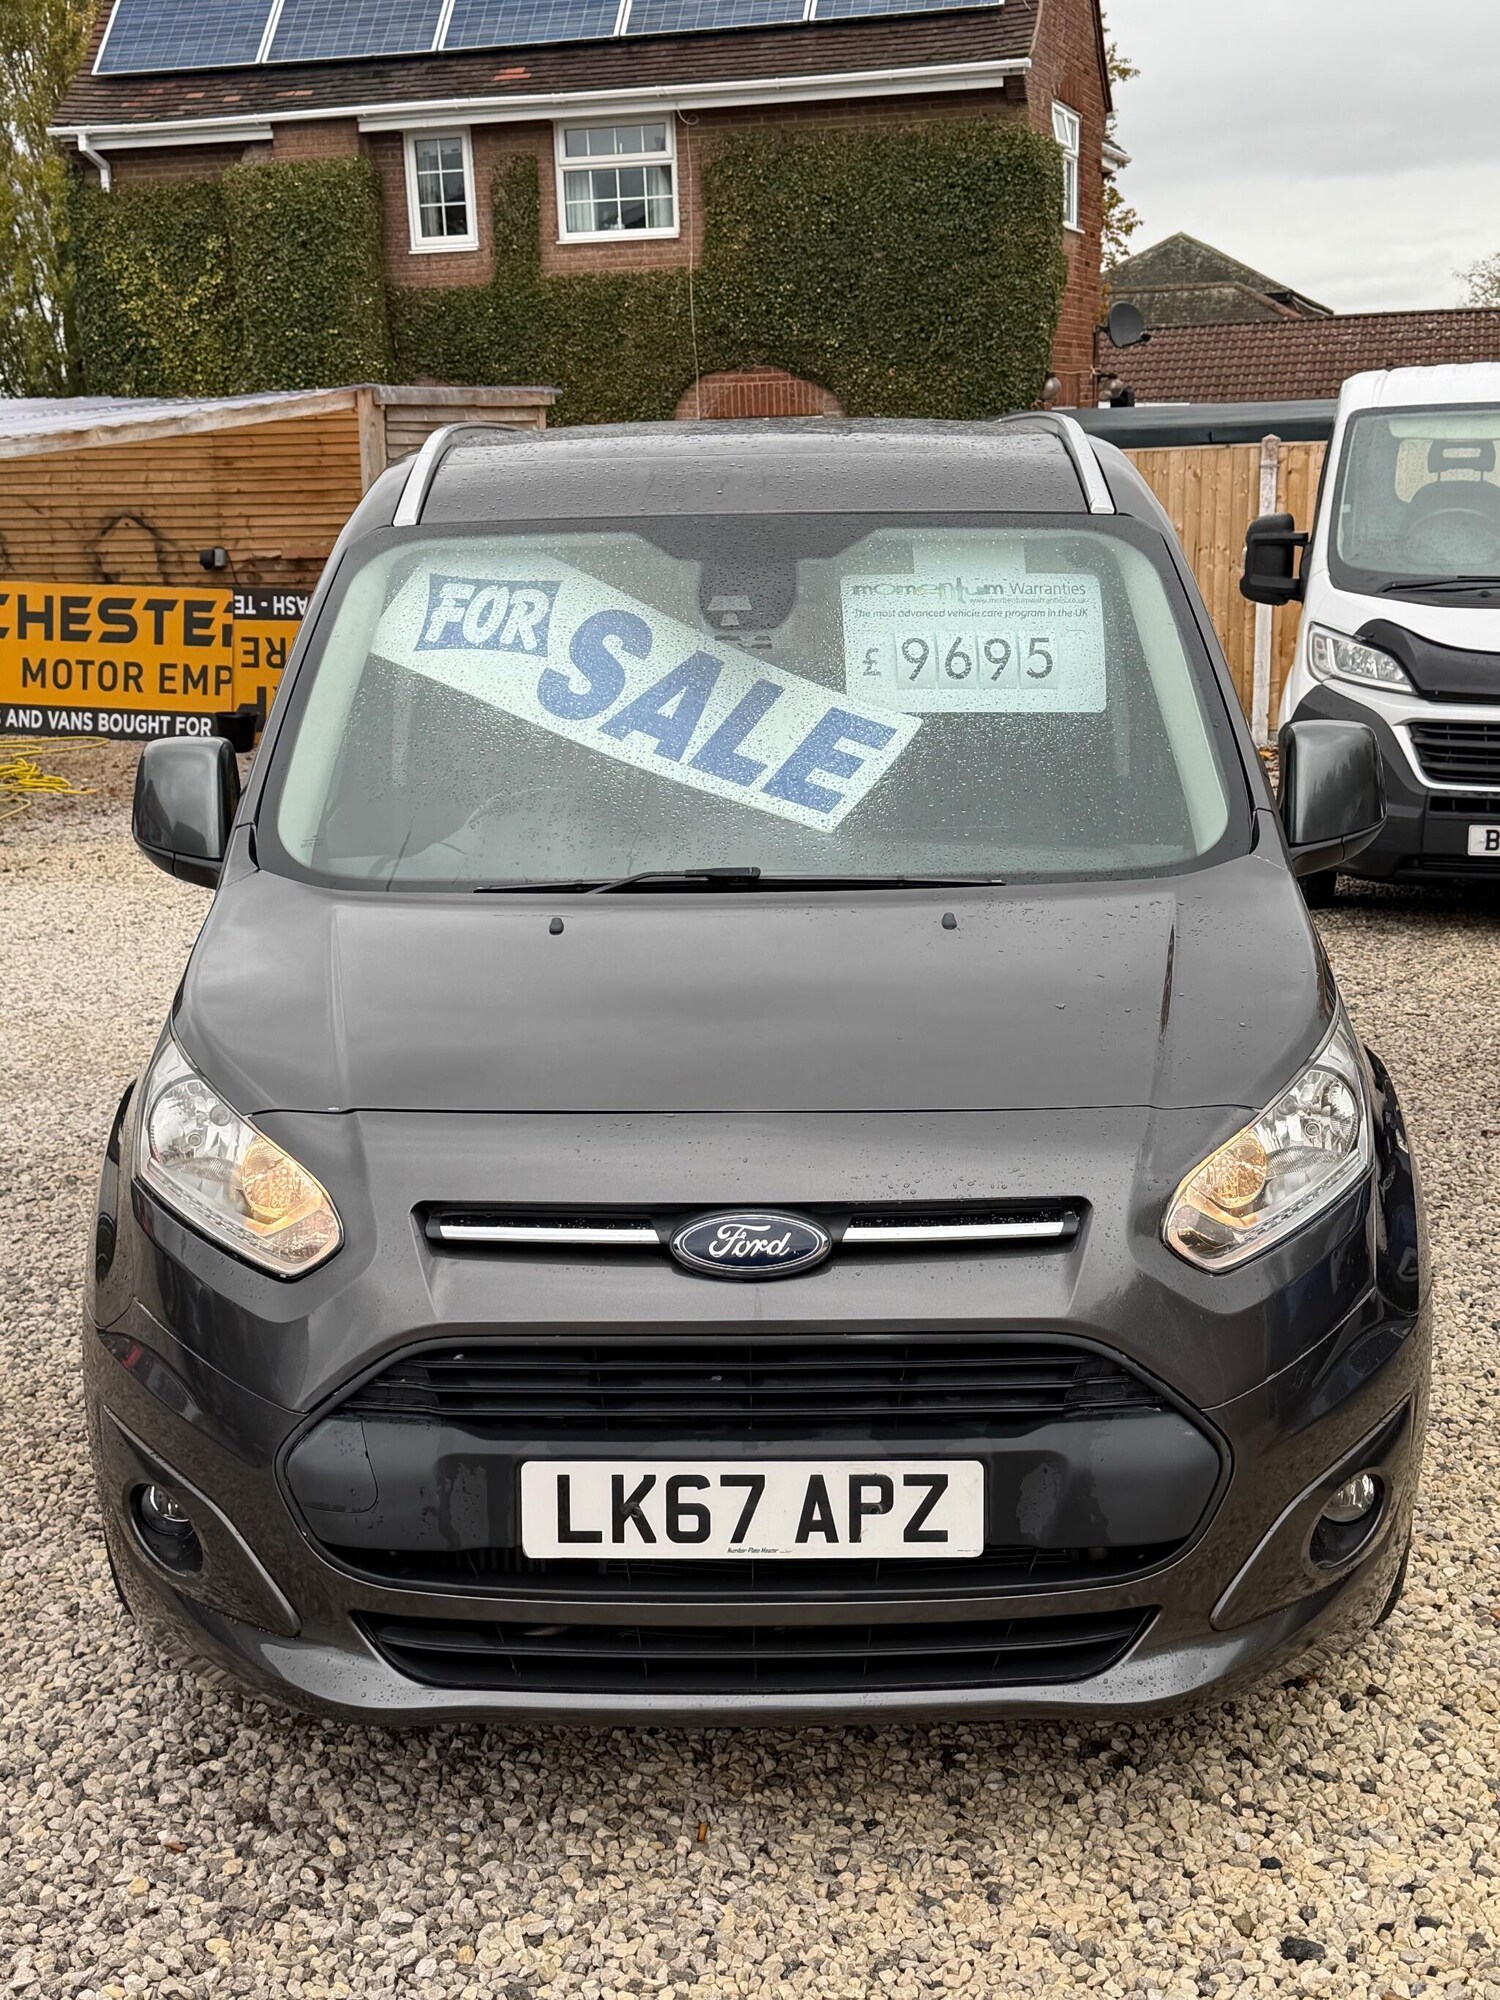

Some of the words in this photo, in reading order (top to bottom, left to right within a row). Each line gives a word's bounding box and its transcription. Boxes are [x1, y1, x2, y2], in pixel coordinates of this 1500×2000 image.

[853, 577, 1003, 603] momentum
[1009, 582, 1086, 595] Warranties
[0, 594, 232, 648] HESTE
[854, 609, 871, 617] The
[873, 609, 896, 617] most
[898, 609, 945, 618] advanced
[948, 609, 979, 617] vehicle
[1005, 610, 1046, 619] program
[1048, 608, 1056, 617] in
[1058, 609, 1073, 617] the
[1076, 609, 1088, 617] UK
[241, 636, 296, 669] RE
[902, 637, 1053, 682] 9695
[22, 657, 144, 693] MOTOR
[159, 662, 232, 696] EMP
[424, 583, 549, 651] FOR
[537, 609, 897, 814] SALE
[5, 708, 43, 729] AND
[47, 710, 94, 731] VANS
[98, 712, 171, 735] BOUGHT
[175, 716, 212, 737] FOR
[708, 1223, 790, 1258] Ford
[557, 1473, 766, 1544] LK67
[795, 1473, 949, 1544] APZ
